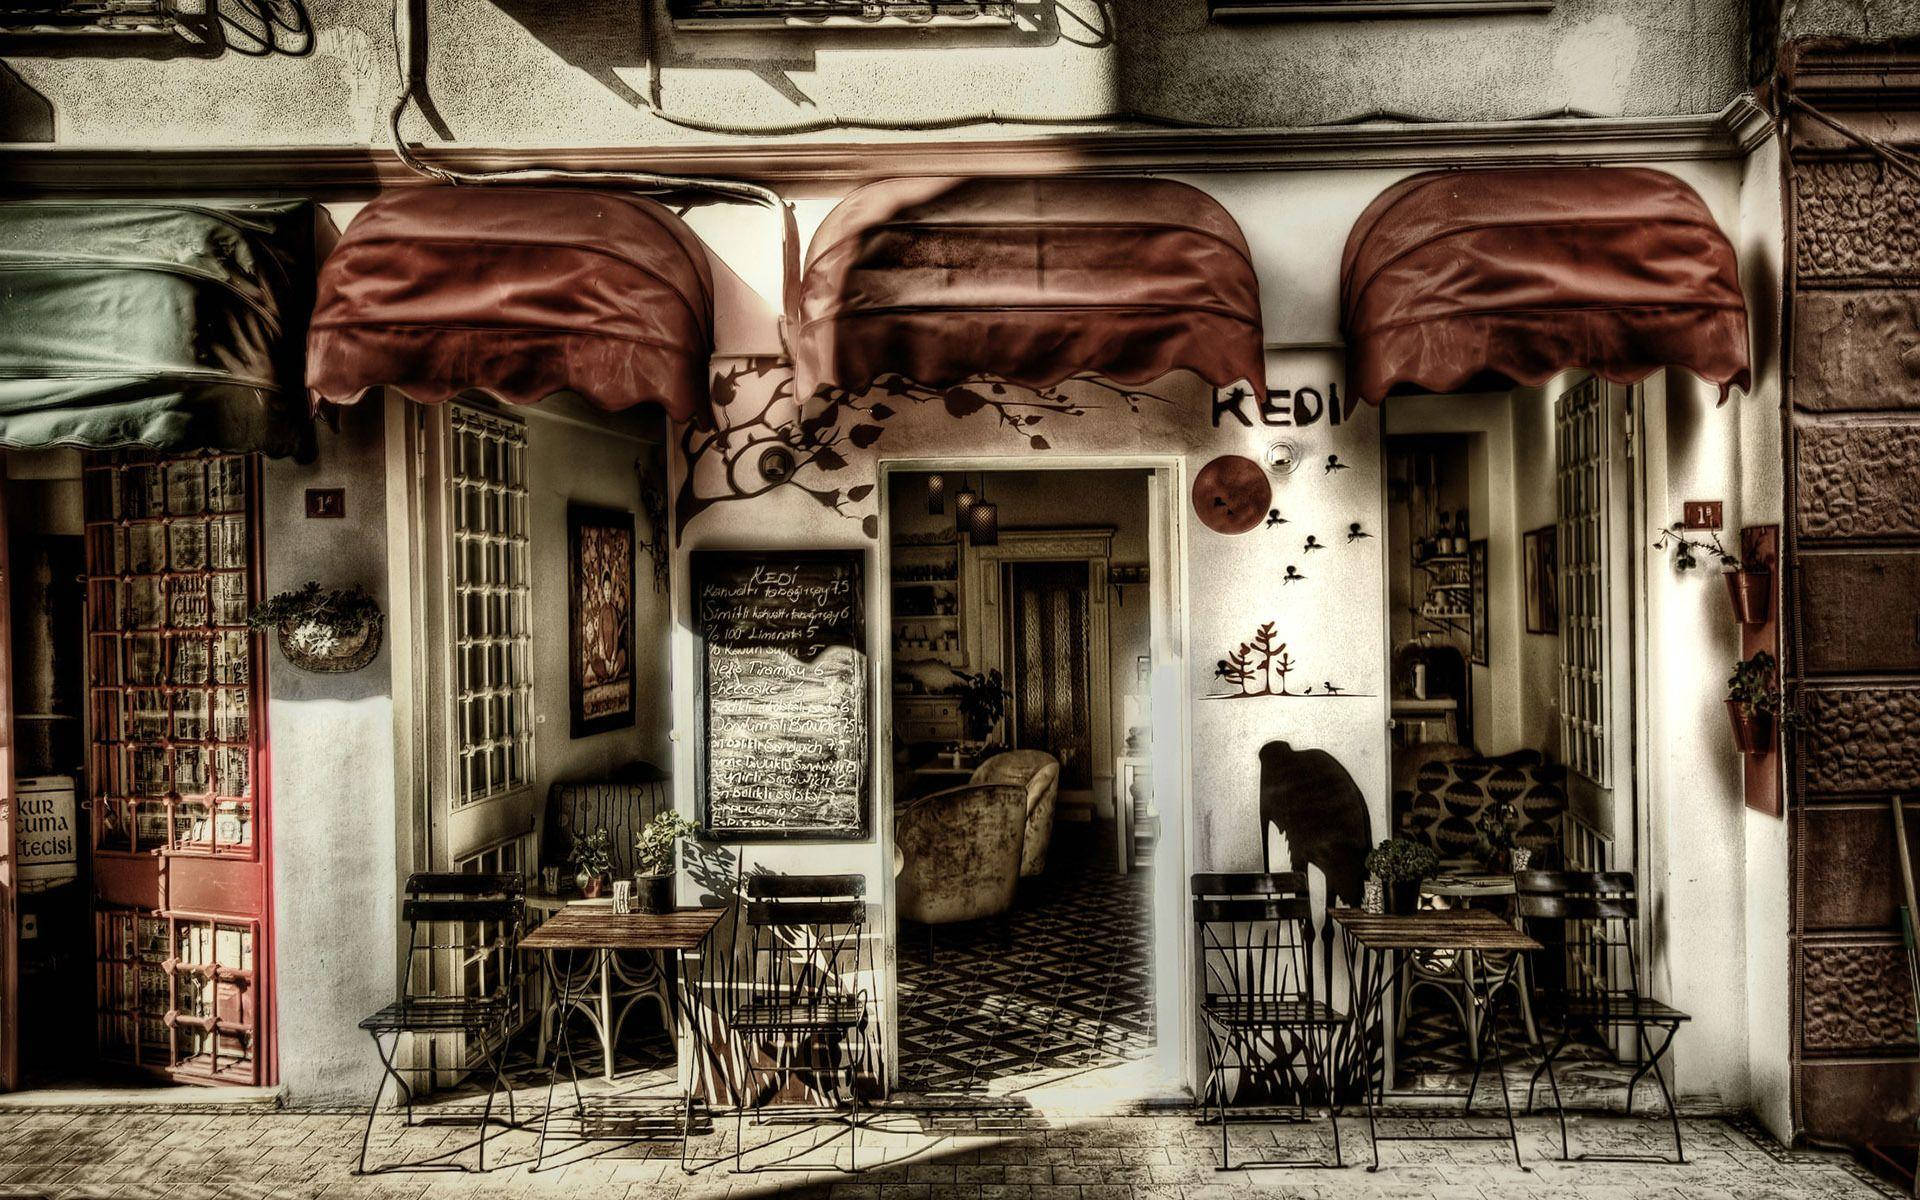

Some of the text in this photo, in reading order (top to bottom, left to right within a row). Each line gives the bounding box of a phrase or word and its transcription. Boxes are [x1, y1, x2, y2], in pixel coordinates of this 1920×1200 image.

[830, 580, 851, 595] 7.5
[840, 606, 850, 619] 6
[724, 628, 742, 640] 100
[807, 626, 819, 638] 5
[807, 644, 826, 656] 5
[814, 661, 824, 676] 6
[793, 680, 804, 697] 6
[840, 700, 850, 713] 6
[835, 774, 847, 788] 6
[790, 804, 806, 819] 5
